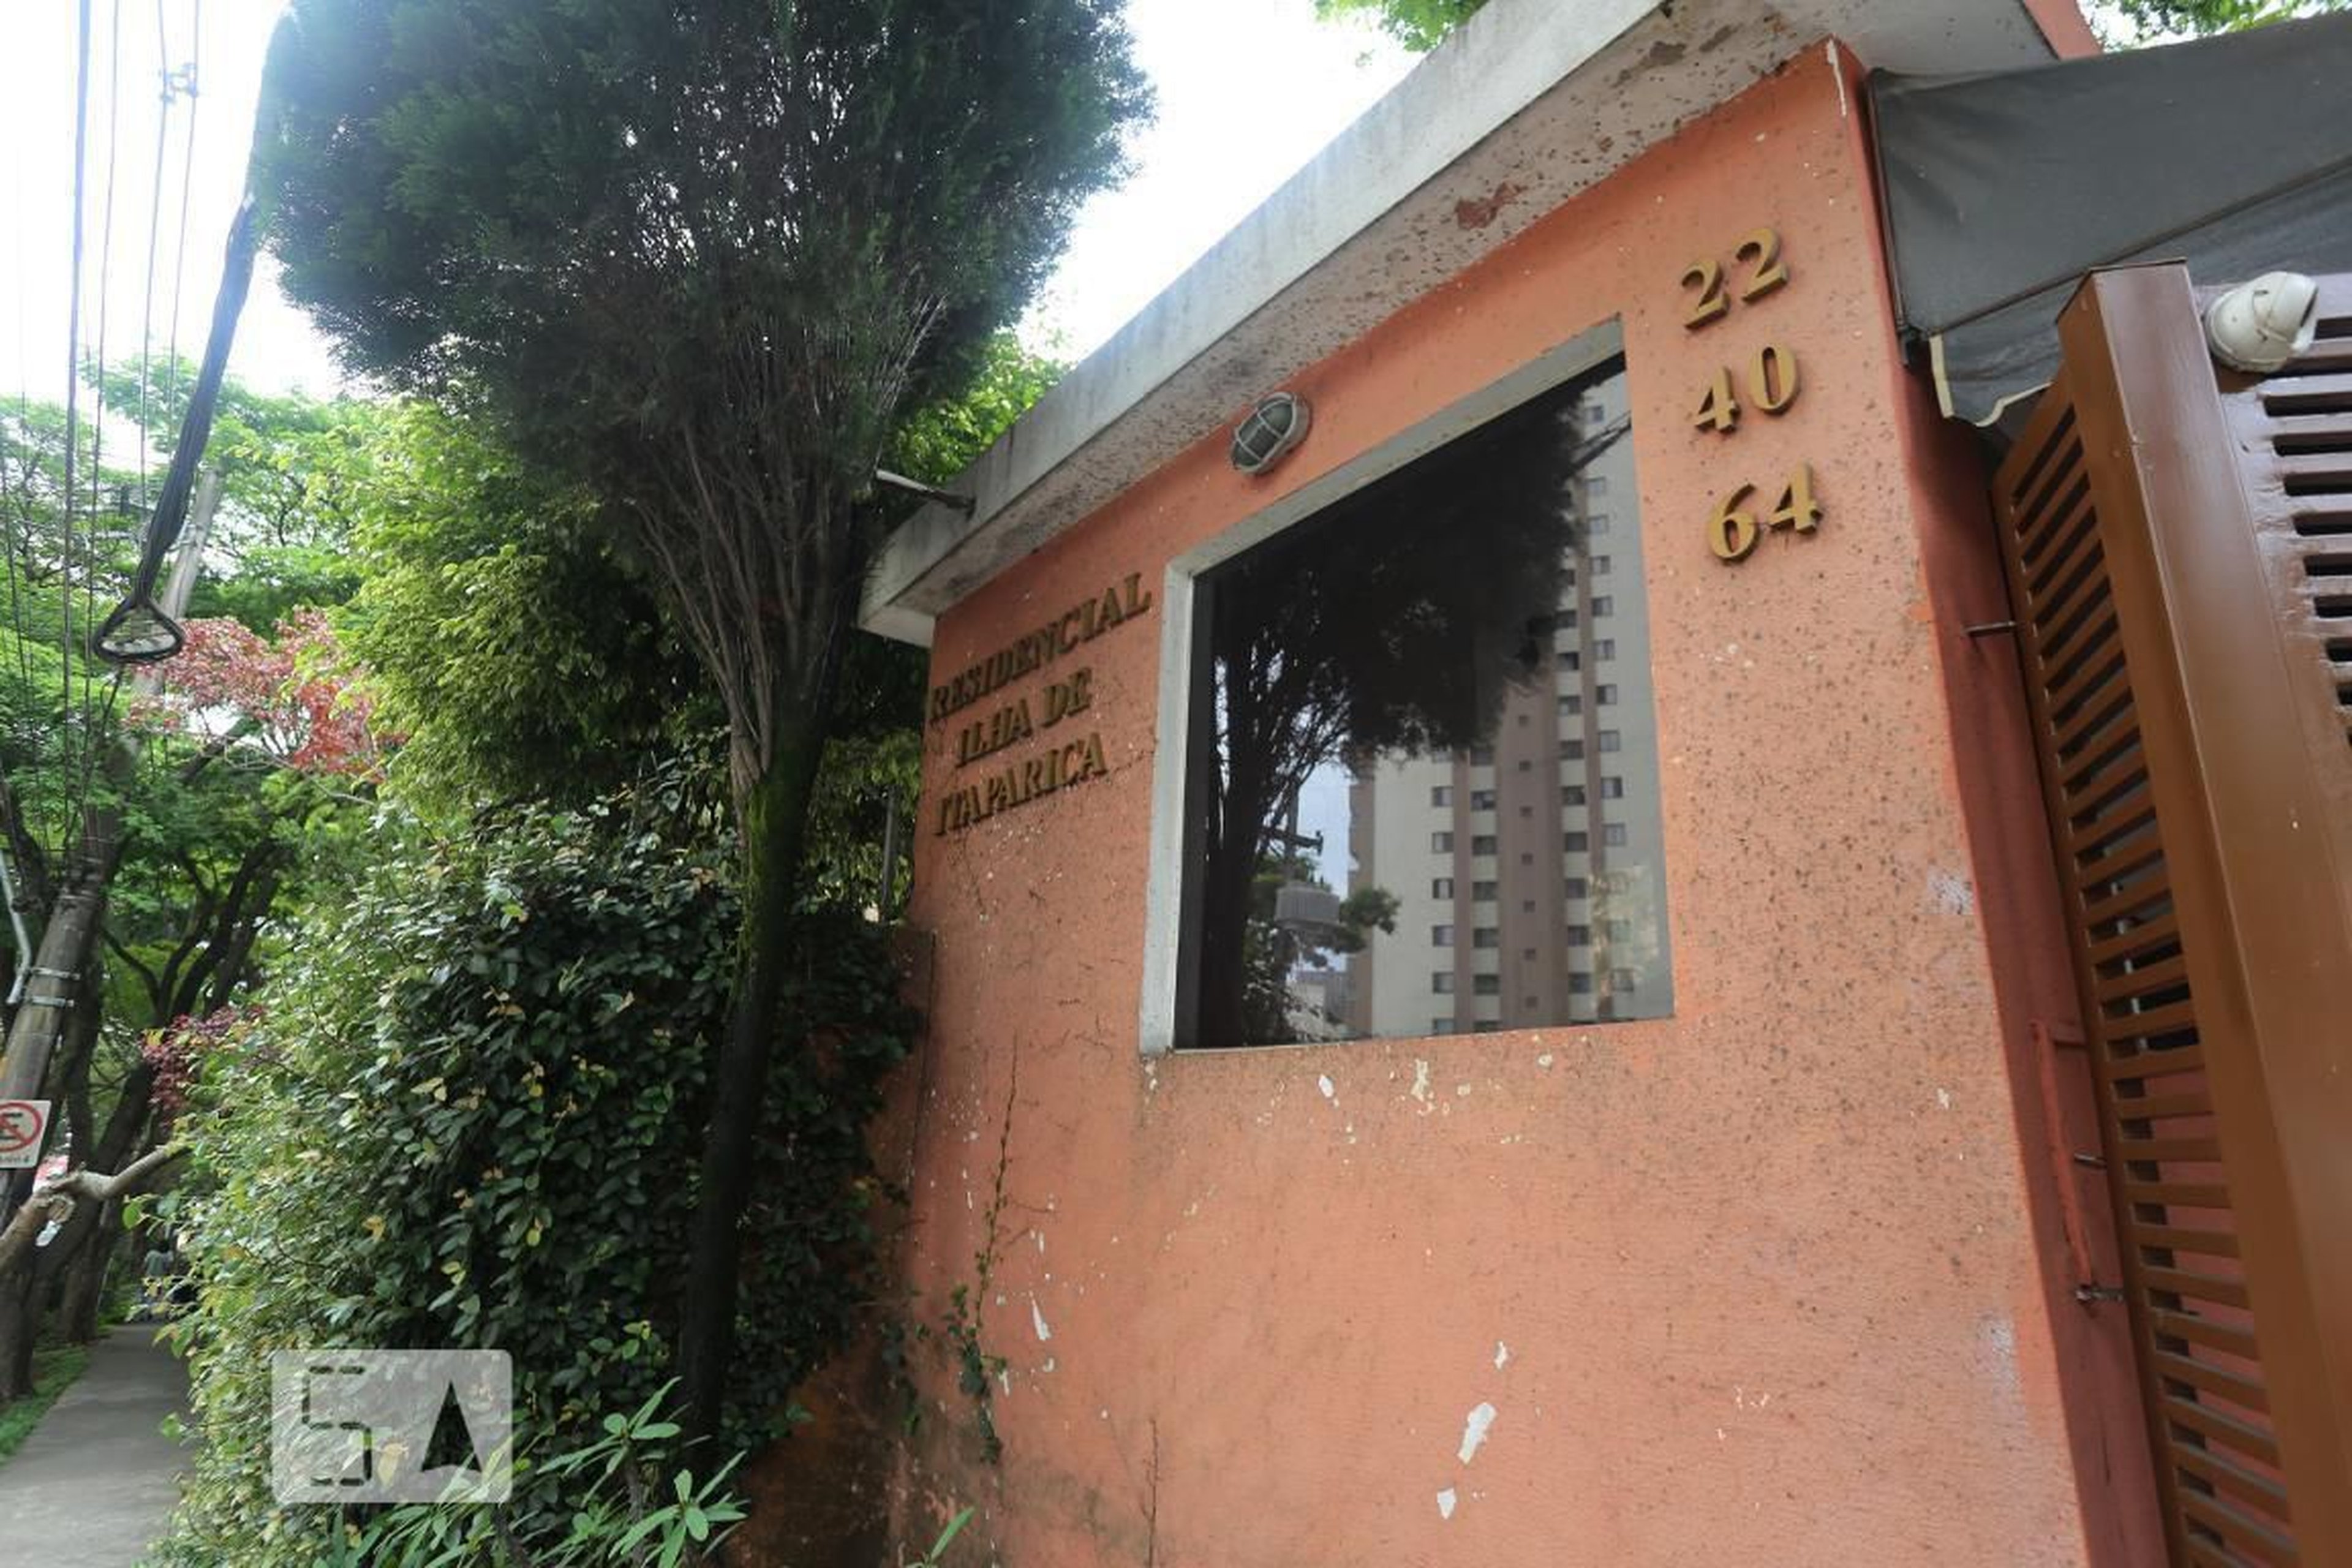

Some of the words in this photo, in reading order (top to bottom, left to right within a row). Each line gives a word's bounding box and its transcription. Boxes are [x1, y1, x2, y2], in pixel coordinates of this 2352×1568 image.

[1681, 227, 1790, 331] 22
[1695, 344, 1801, 432] 40
[1708, 461, 1823, 565] 64
[930, 572, 1152, 722] RESIDENCIAL
[956, 698, 1033, 769] ILHA
[1041, 666, 1093, 727] DE
[935, 732, 1107, 837] ITAPARICA
